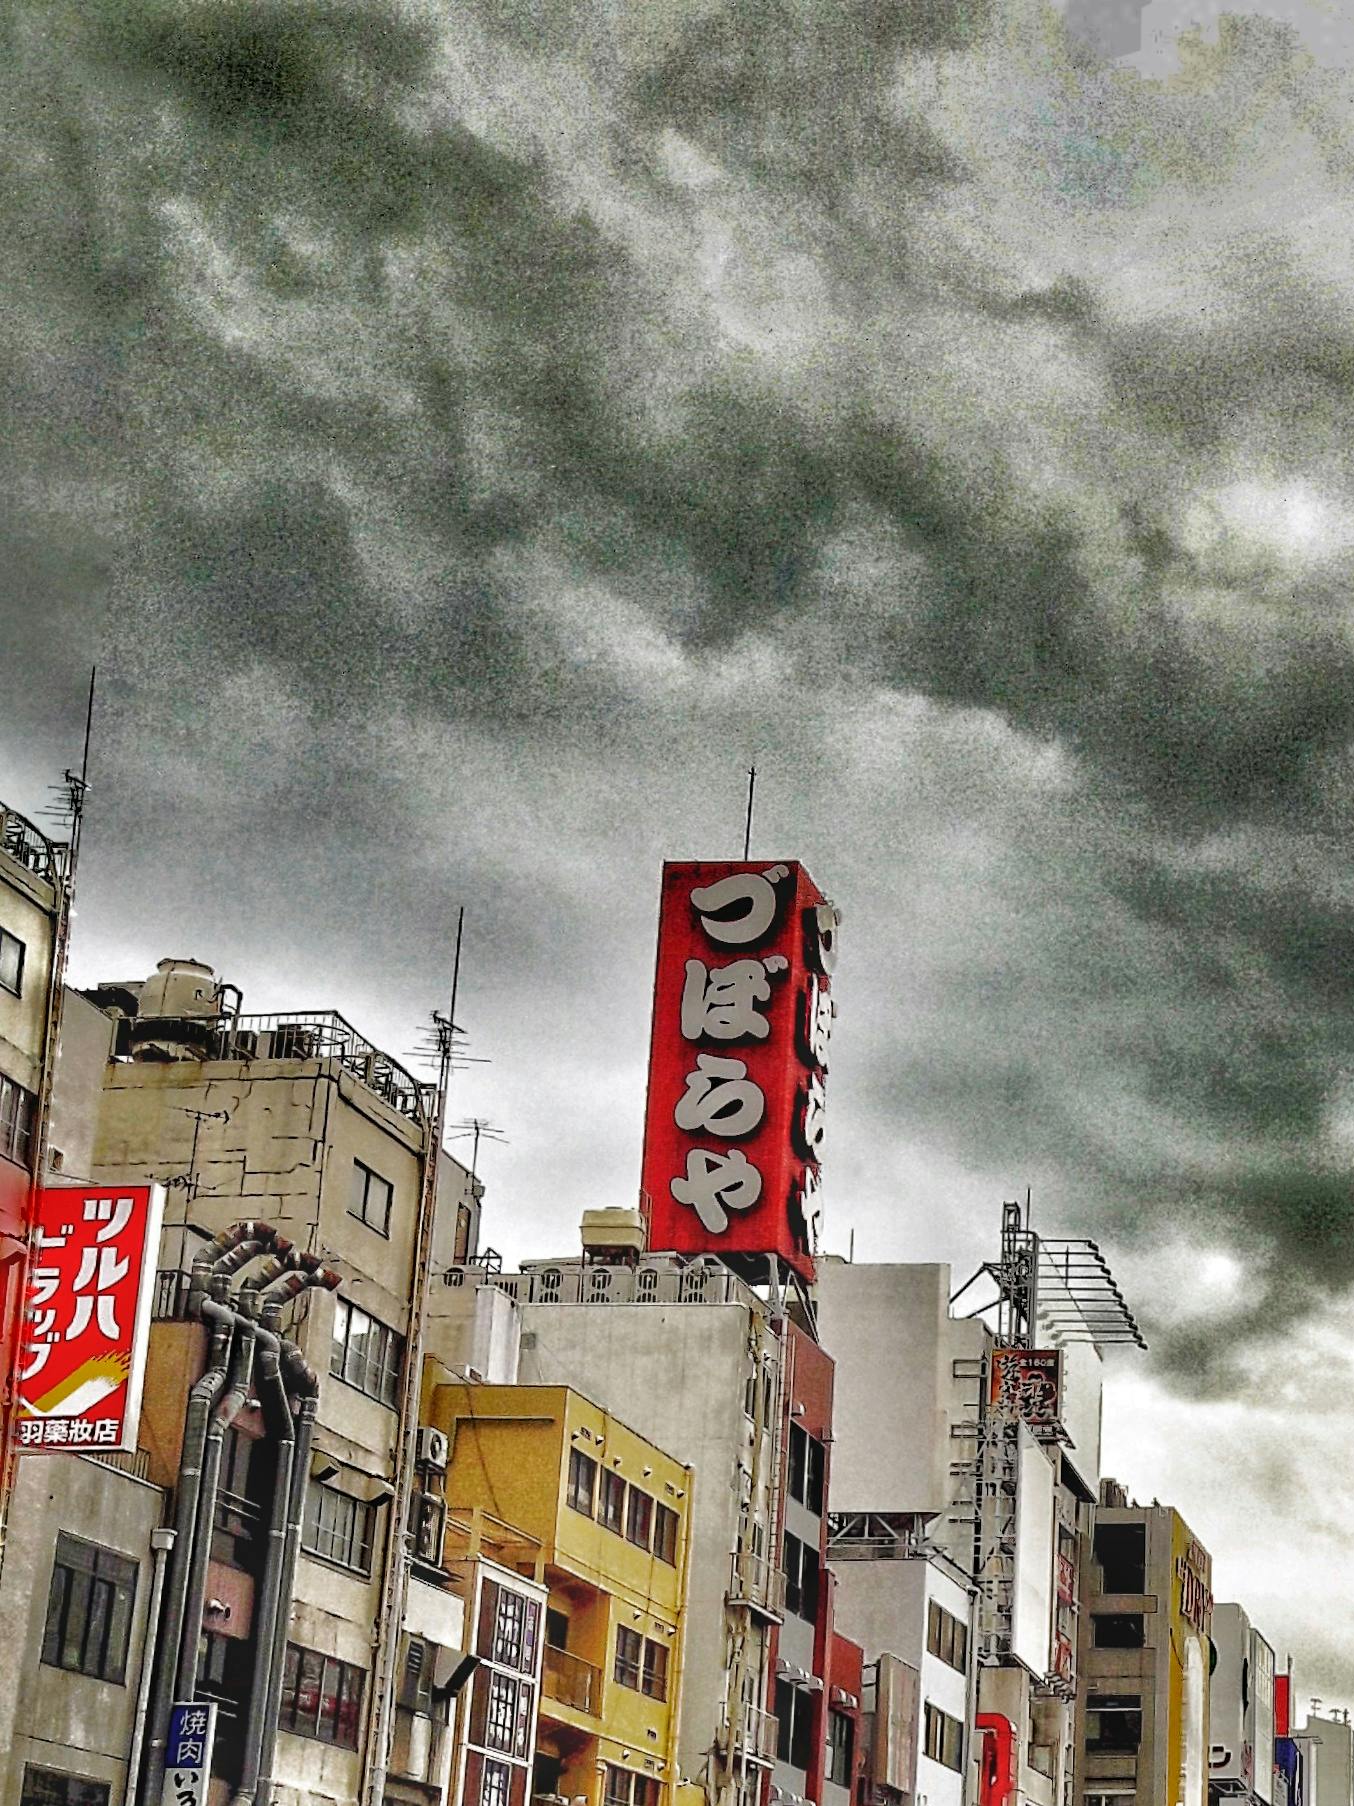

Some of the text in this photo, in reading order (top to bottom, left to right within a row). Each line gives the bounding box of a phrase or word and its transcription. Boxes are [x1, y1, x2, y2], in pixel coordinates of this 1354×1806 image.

[670, 864, 790, 1233] づぼらや
[66, 1199, 134, 1340] ツルハ
[177, 1709, 207, 1764] 焼肉
